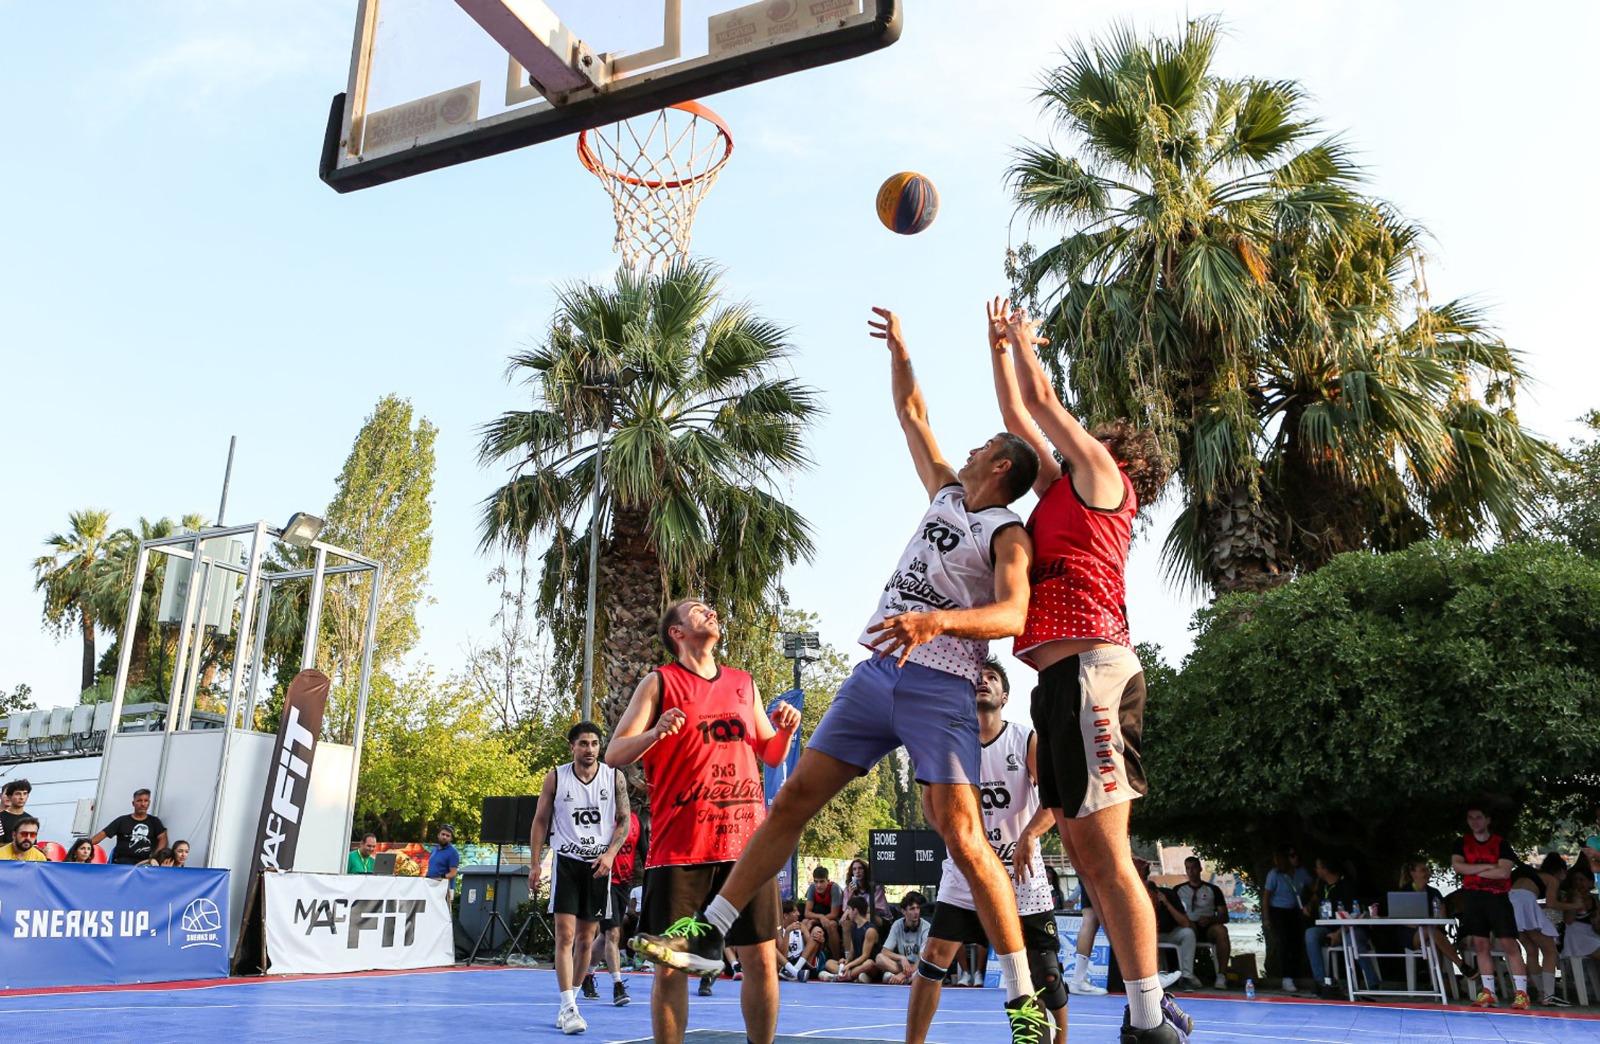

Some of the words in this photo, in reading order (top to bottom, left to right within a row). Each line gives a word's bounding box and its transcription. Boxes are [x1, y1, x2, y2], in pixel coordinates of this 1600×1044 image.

[1092, 705, 1118, 793] JORDAN
[711, 763, 736, 778] 3x3
[733, 808, 755, 823] Cup
[715, 824, 740, 835] 2023
[987, 828, 1002, 842] x3
[580, 836, 596, 845] 3x3
[873, 833, 897, 845] HOME
[876, 851, 896, 861] SCORE
[914, 849, 934, 862] TIME
[14, 909, 115, 938] SNEAKS
